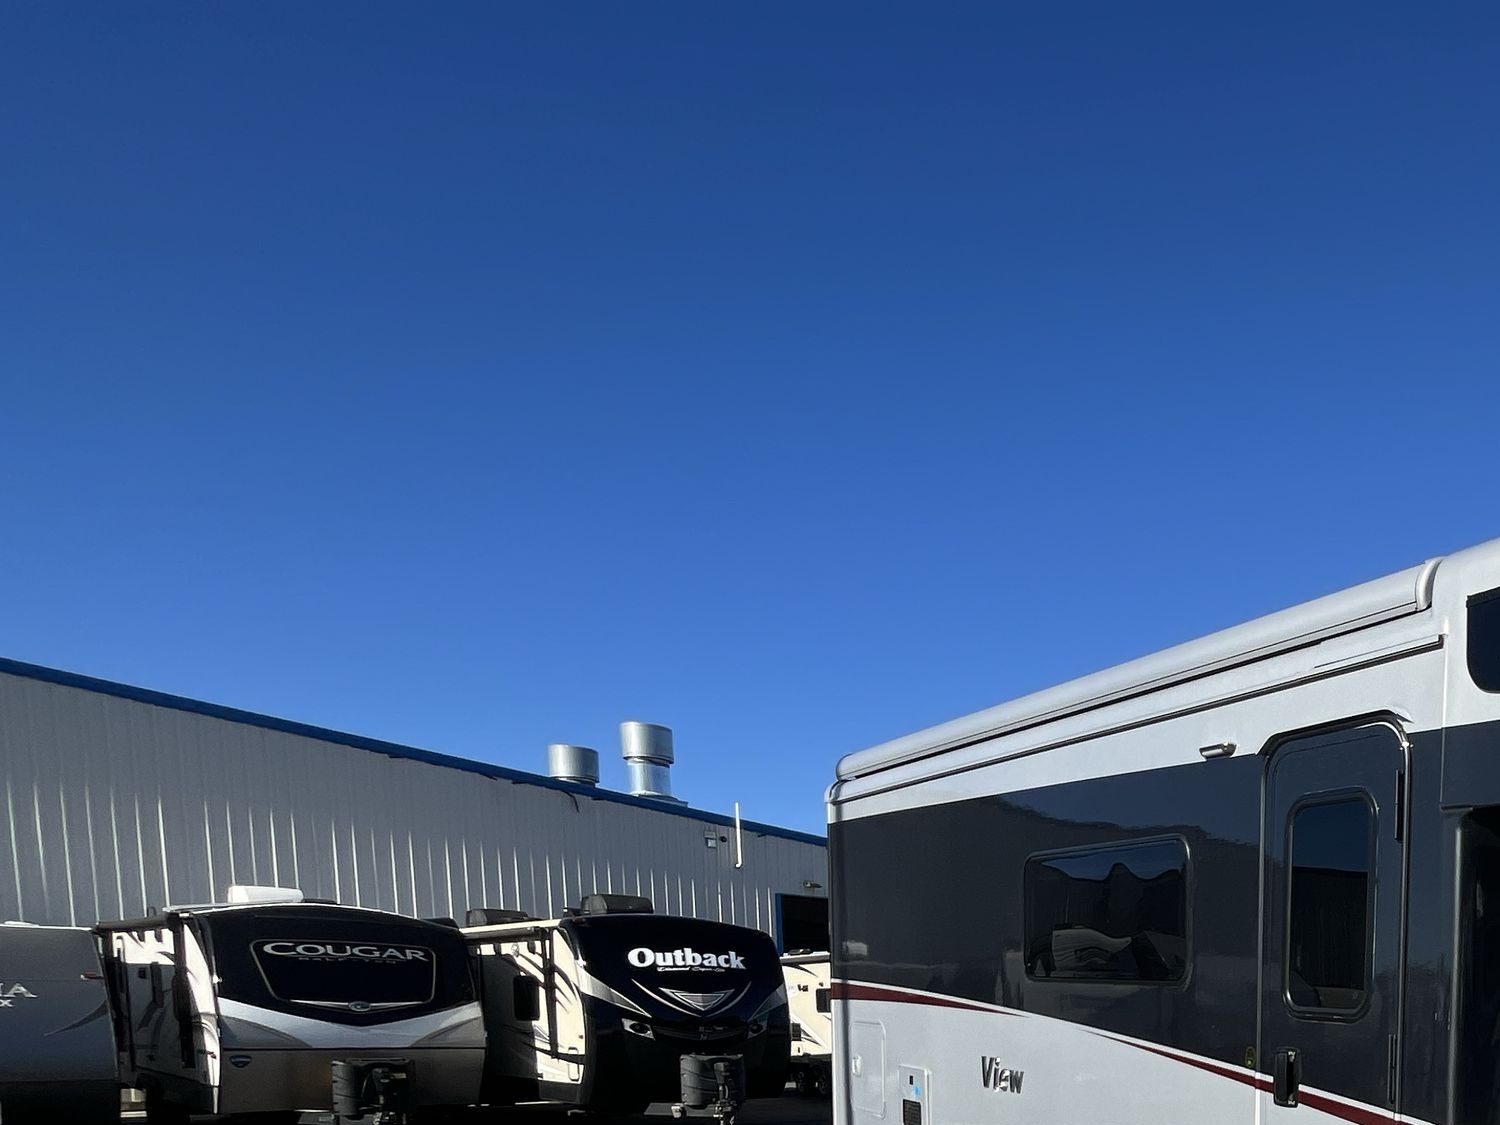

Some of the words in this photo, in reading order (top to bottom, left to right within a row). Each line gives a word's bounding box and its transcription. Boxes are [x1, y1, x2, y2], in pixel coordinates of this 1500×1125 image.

[263, 942, 429, 961] COUGAR
[627, 947, 747, 969] Outback
[981, 1056, 1024, 1094] View
